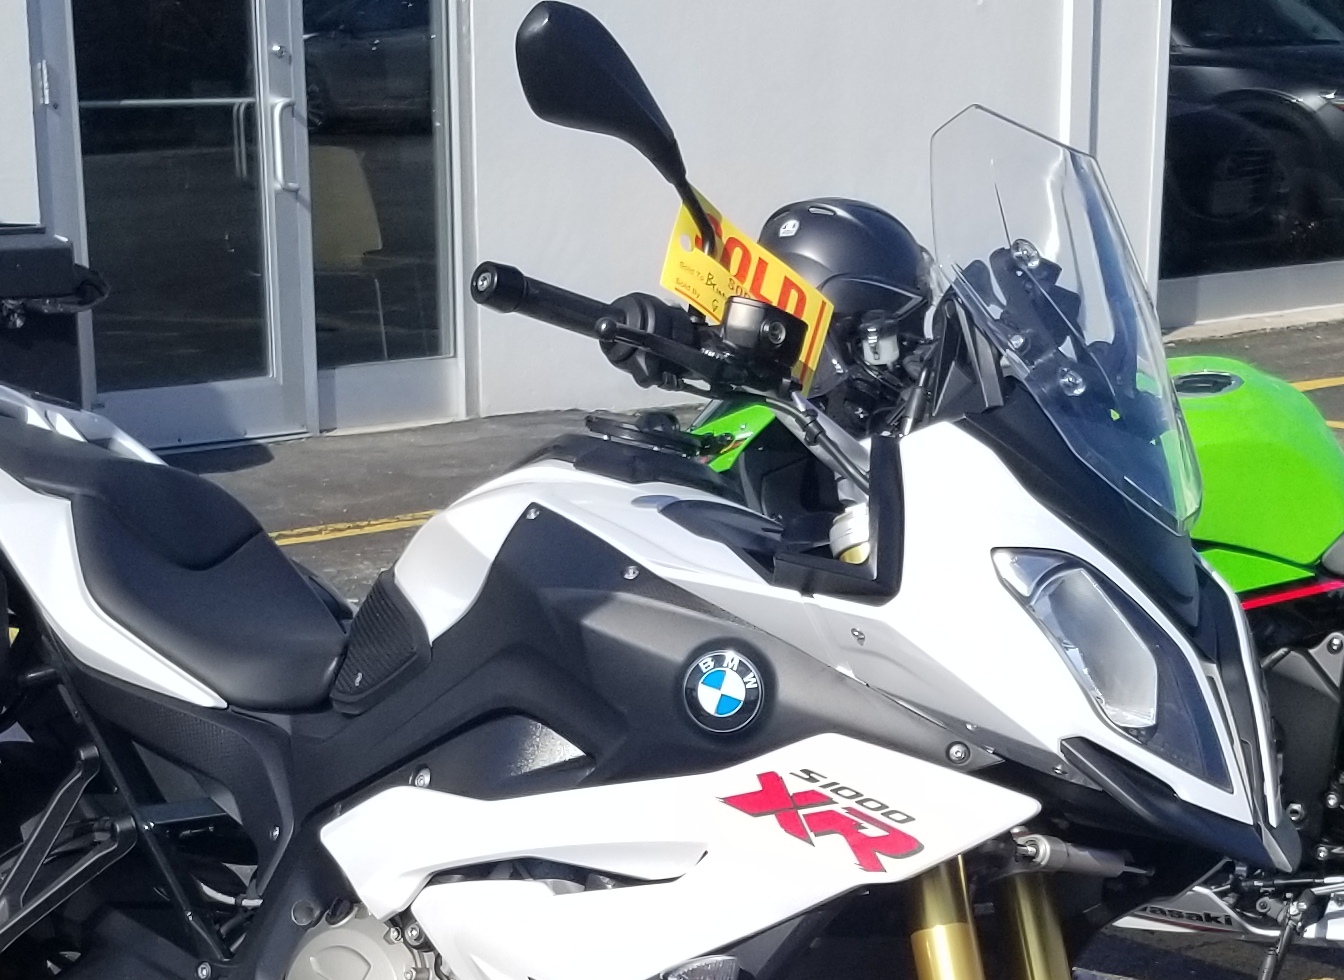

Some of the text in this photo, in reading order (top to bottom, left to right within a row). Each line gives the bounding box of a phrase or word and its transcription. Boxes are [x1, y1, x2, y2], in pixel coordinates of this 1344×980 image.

[698, 651, 758, 689] BMW
[716, 770, 925, 873] XR
[789, 768, 916, 824] S1000
